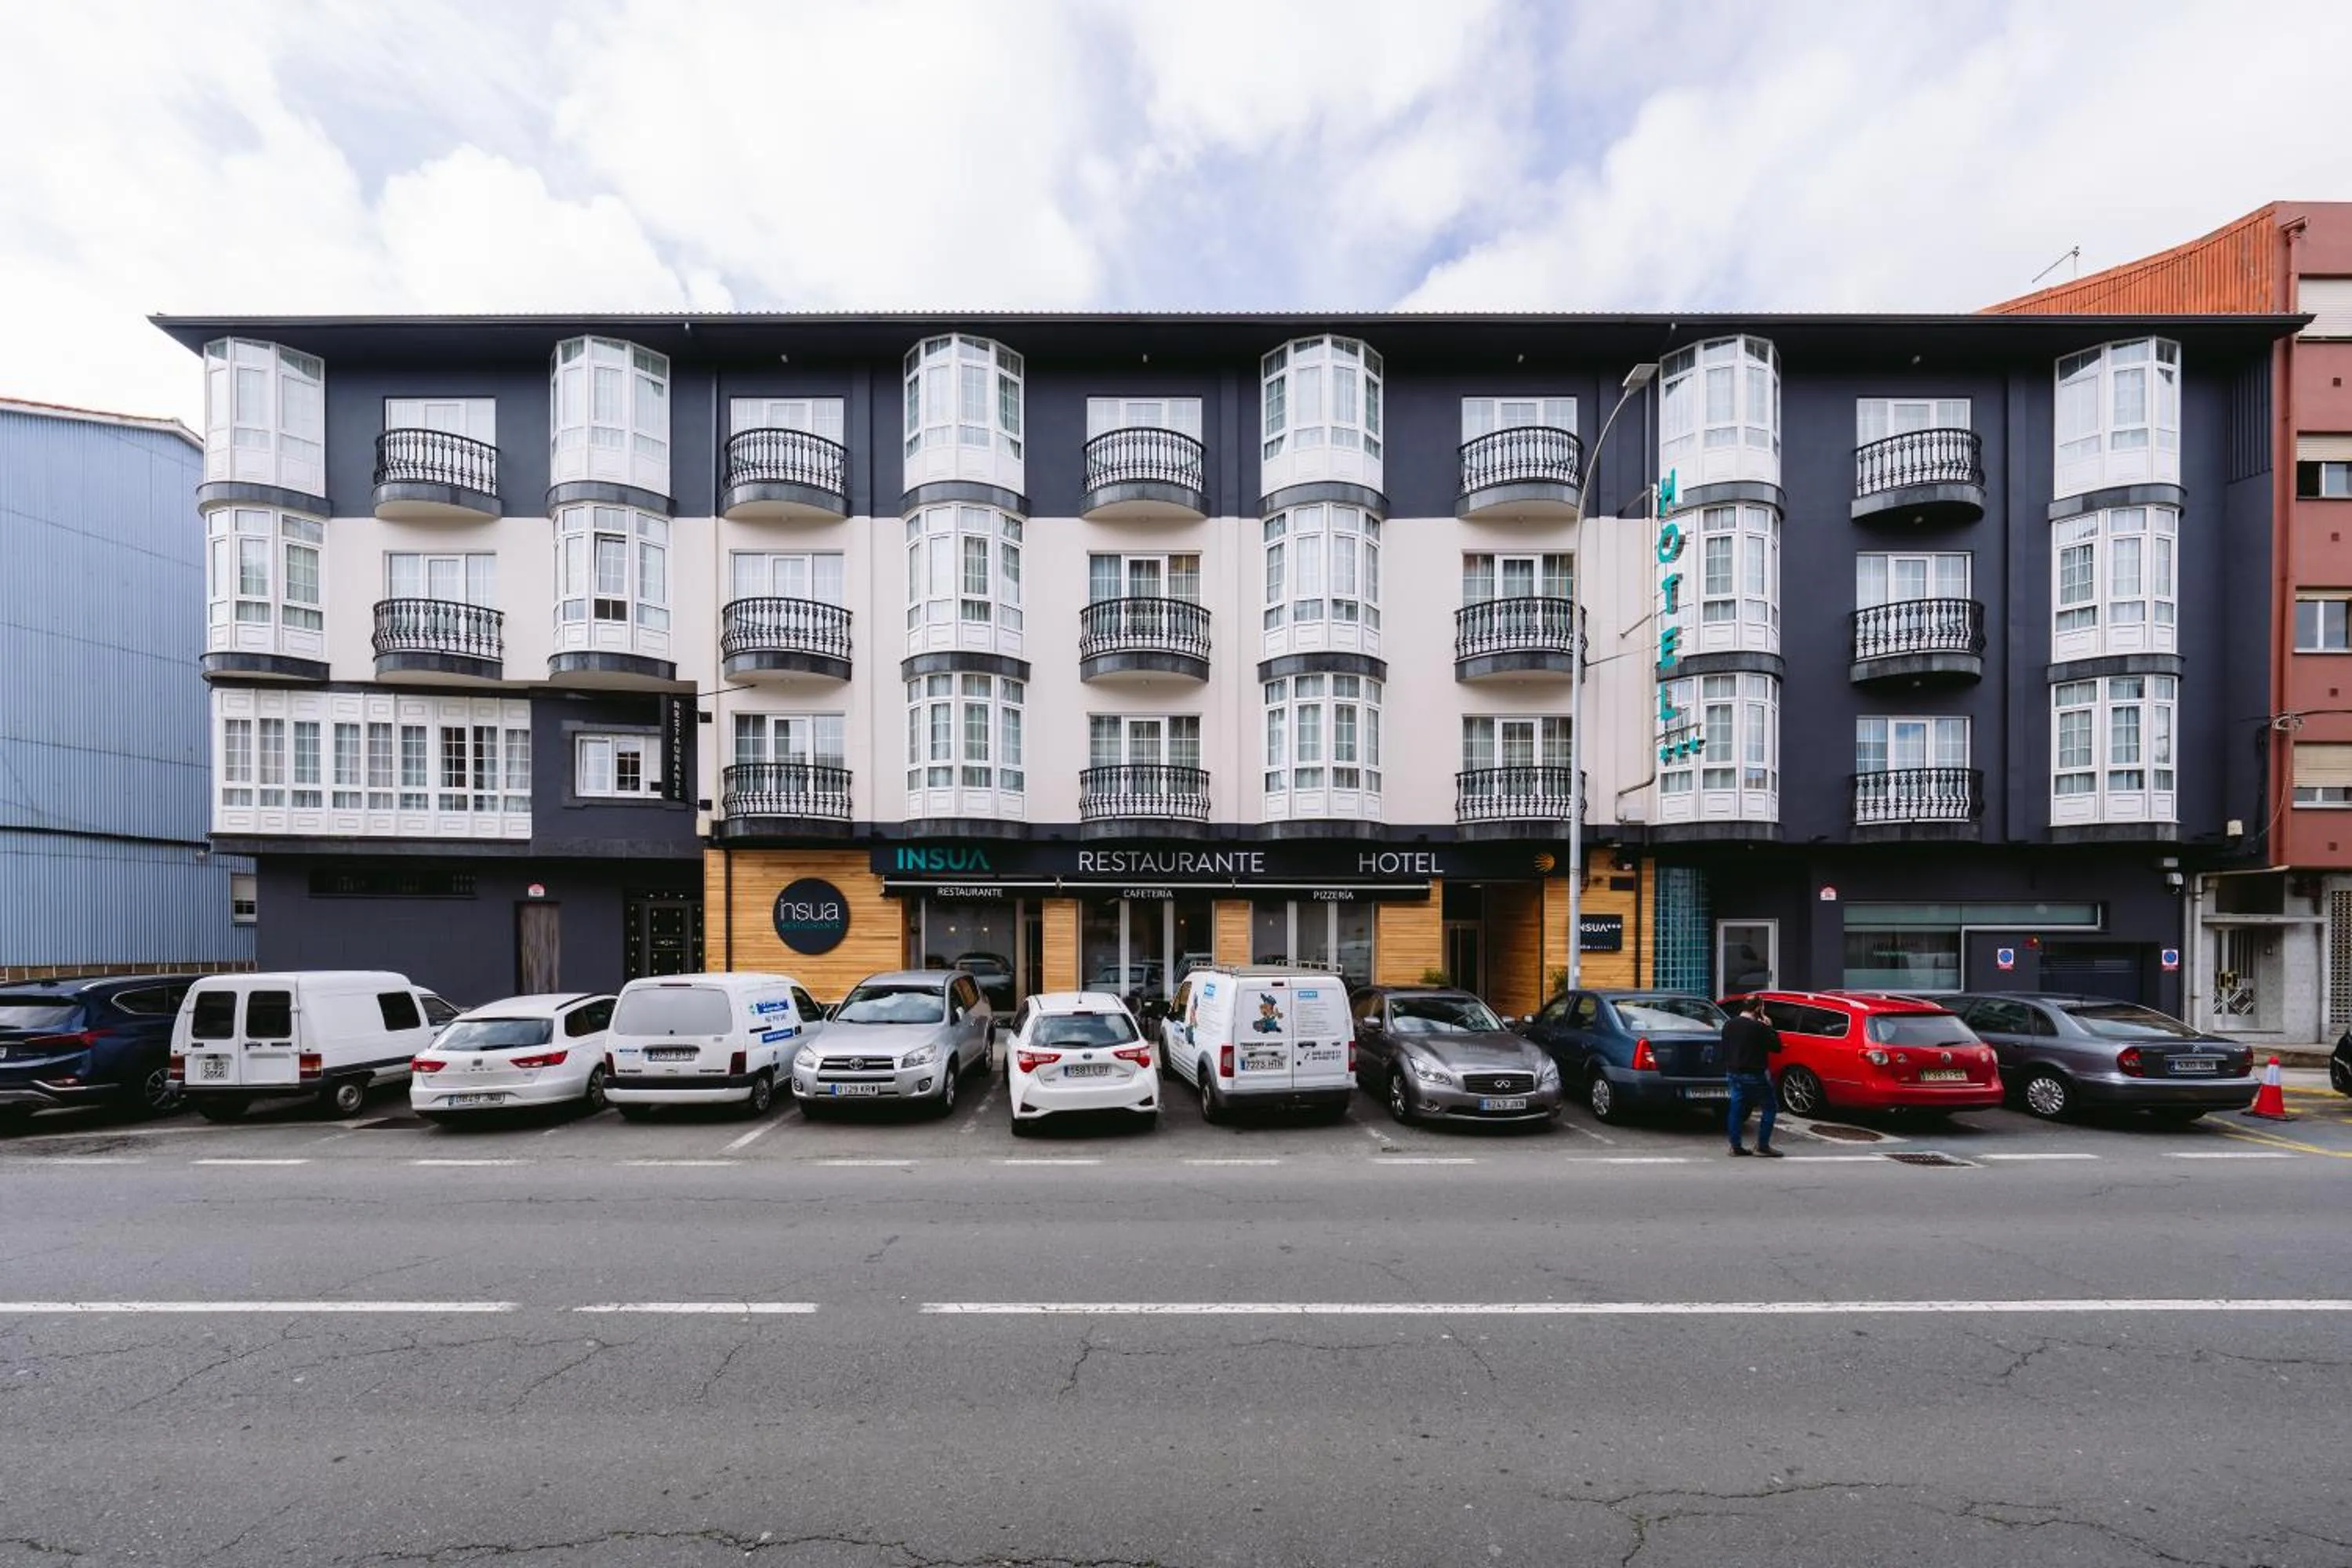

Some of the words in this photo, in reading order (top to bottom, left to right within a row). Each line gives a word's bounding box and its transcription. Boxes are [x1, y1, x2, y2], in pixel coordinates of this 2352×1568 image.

[1657, 467, 1683, 720] HOTEL
[897, 847, 990, 870] INSUA
[1078, 851, 1265, 873] RESTAURANTE
[1359, 852, 1445, 873] HOTEL
[938, 887, 1003, 898] RESTAURANTE
